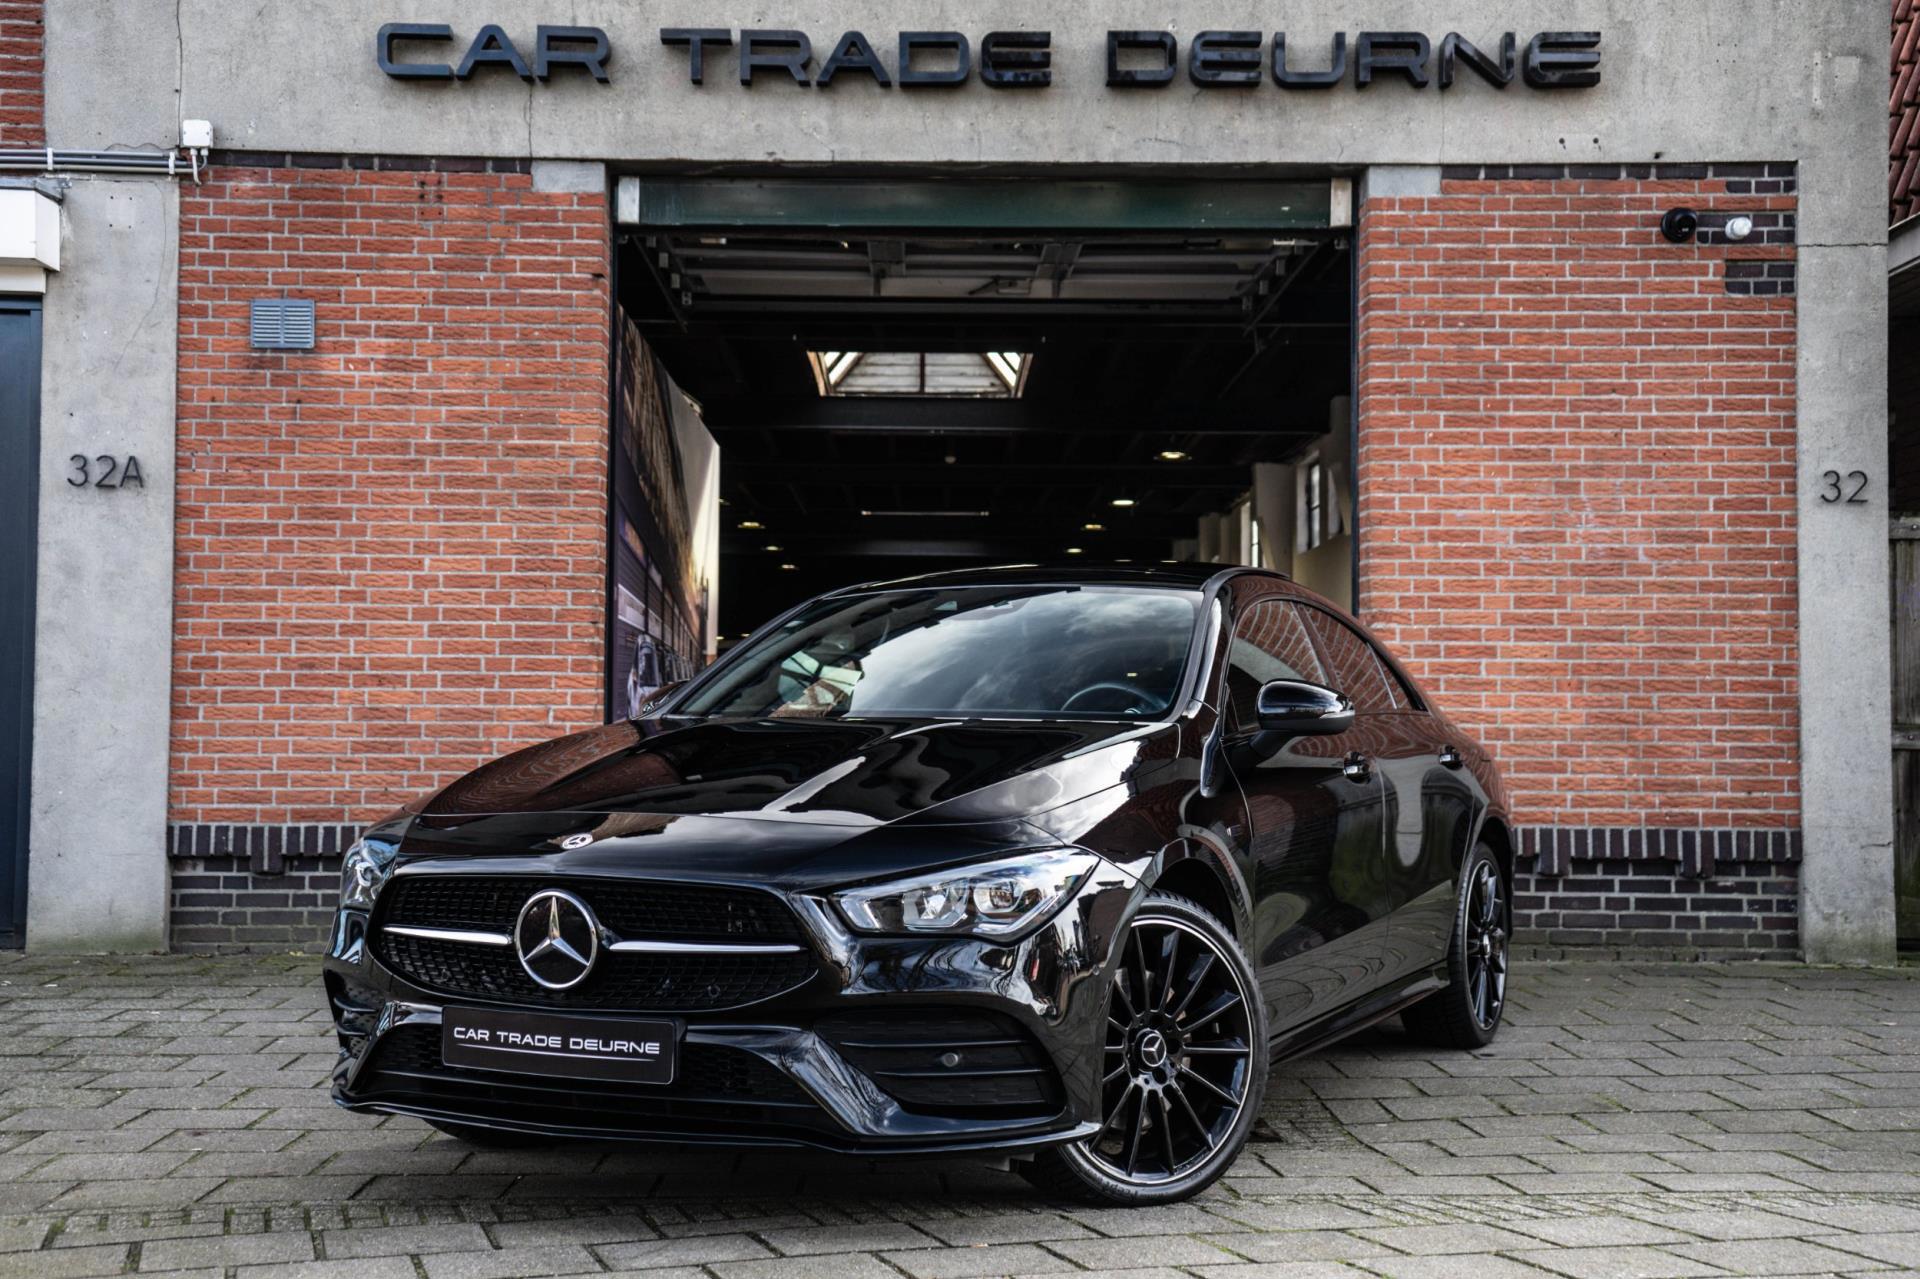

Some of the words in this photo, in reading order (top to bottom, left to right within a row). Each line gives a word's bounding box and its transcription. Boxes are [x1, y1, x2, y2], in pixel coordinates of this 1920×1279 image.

[376, 22, 611, 84] CAR
[660, 28, 1052, 88] TRADE
[1106, 31, 1601, 89] DEURNE
[66, 454, 144, 488] 32A
[1820, 470, 1869, 503] 32
[453, 1026, 490, 1042] CAR
[496, 1031, 562, 1048] TRADE
[569, 1036, 661, 1055] DEURNE
